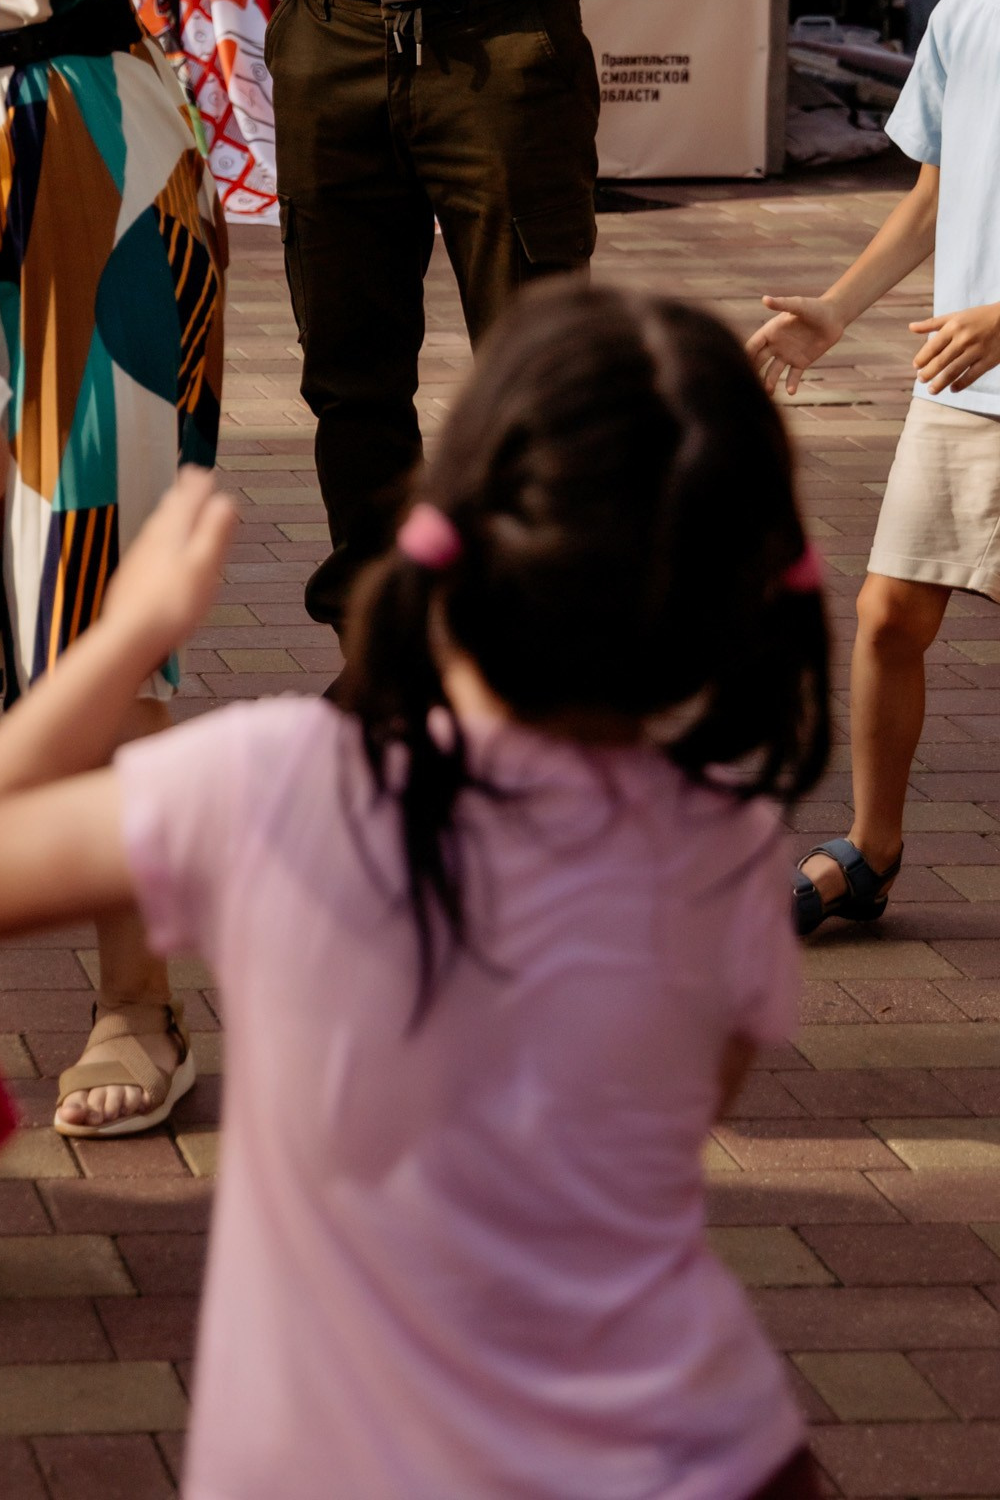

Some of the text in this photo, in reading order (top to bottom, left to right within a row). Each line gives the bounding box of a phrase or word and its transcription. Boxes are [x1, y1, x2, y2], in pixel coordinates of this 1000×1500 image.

[601, 53, 690, 67] Правительство
[601, 68, 689, 84] СМОЛЕНСКОЙ
[600, 89, 659, 102] ОБЛАСТИ
